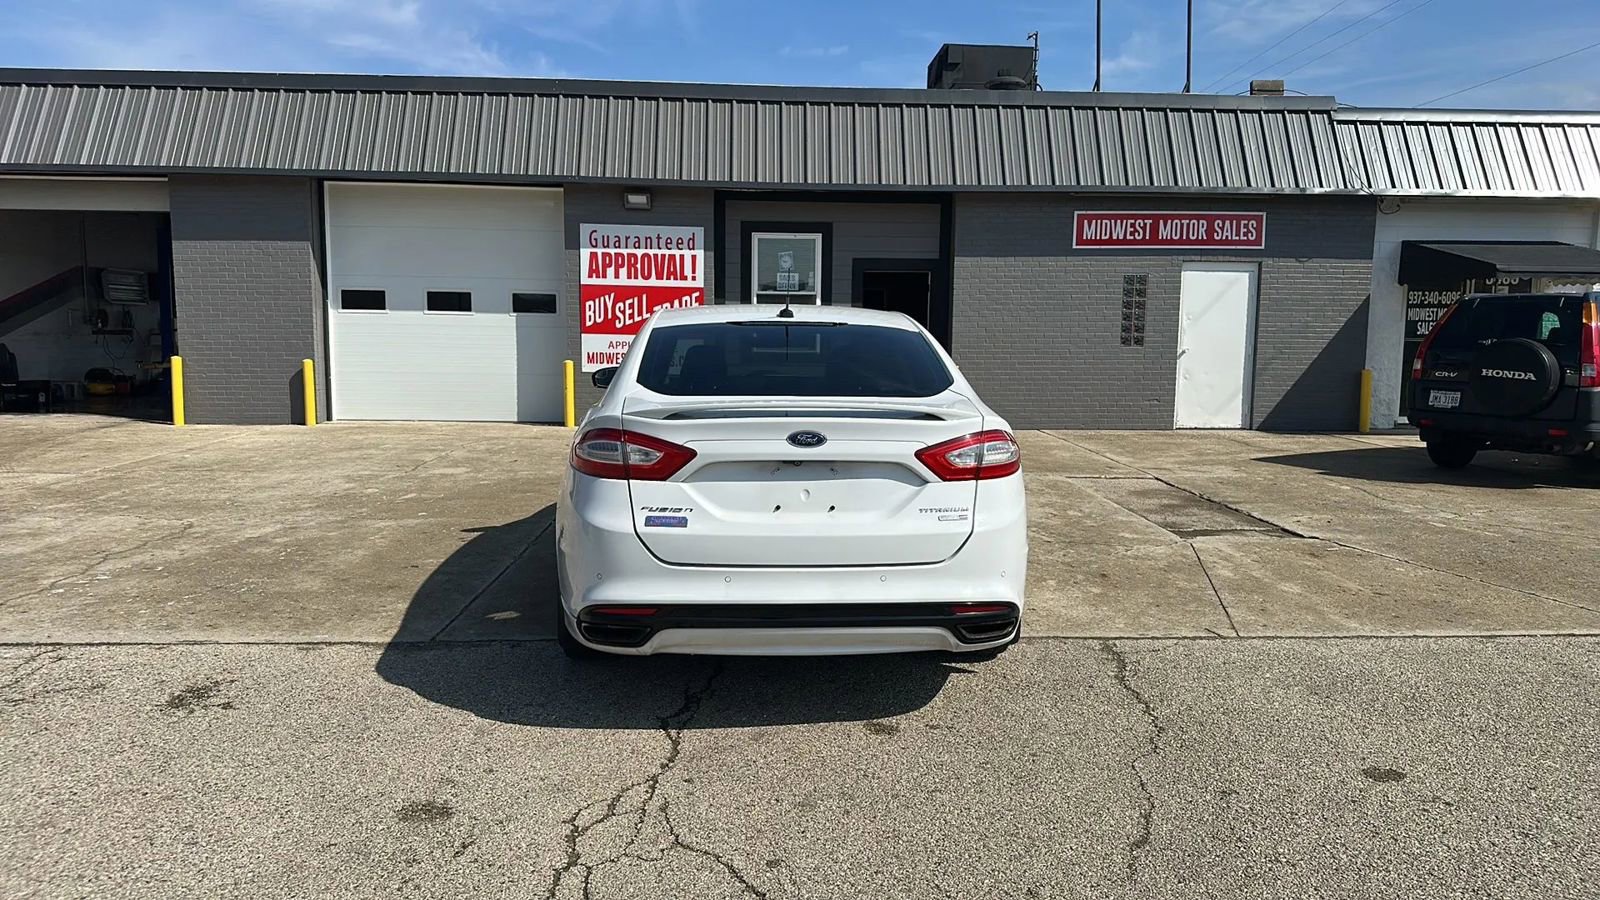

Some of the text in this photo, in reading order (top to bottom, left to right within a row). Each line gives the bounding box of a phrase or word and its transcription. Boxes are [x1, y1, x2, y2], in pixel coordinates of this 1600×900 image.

[589, 230, 695, 250] Guaranteed
[1083, 220, 1256, 240] MIDWEST MOTOR SALES
[588, 252, 697, 281] APPROVAL!
[586, 292, 615, 327] BUY
[615, 293, 651, 329] SELL
[1408, 308, 1437, 321] MIDWEST
[1416, 321, 1437, 335] SALE
[1481, 369, 1537, 381] HONDA
